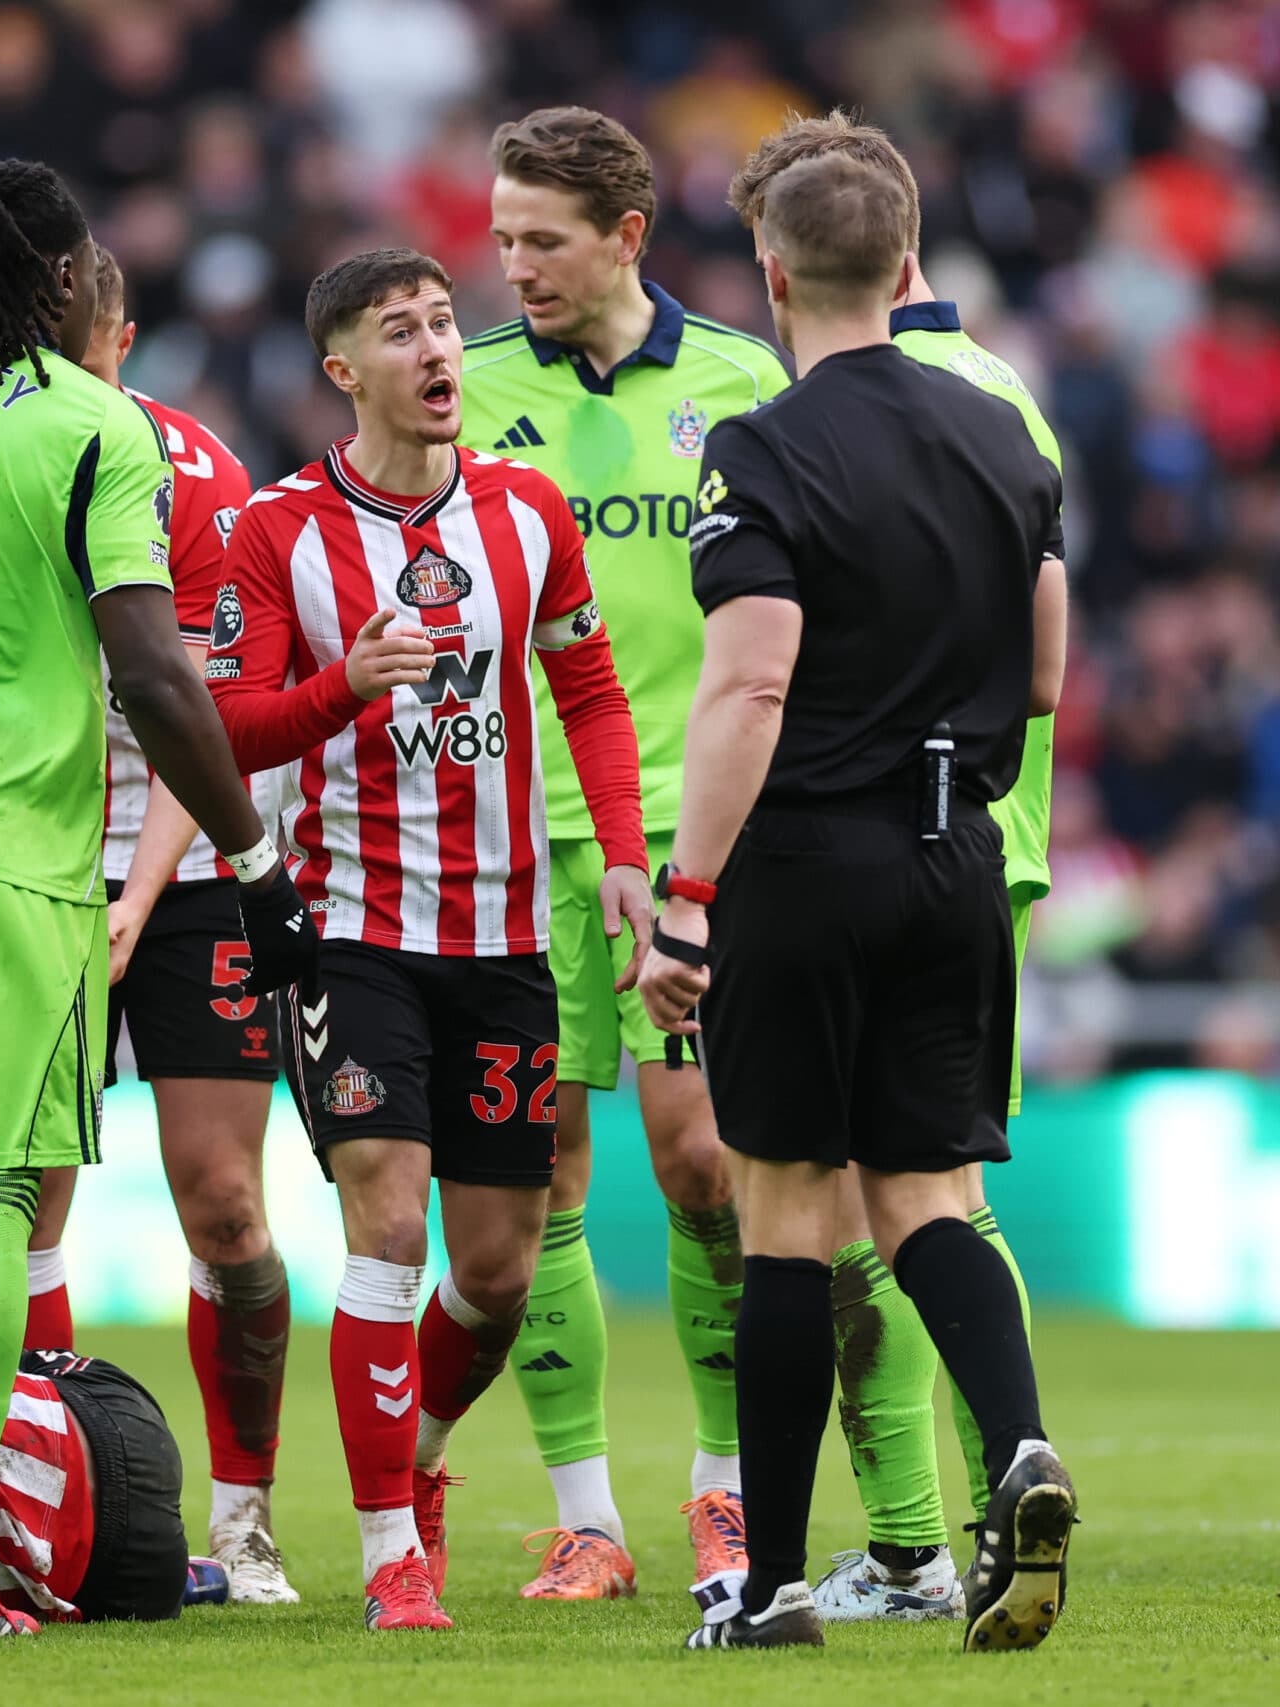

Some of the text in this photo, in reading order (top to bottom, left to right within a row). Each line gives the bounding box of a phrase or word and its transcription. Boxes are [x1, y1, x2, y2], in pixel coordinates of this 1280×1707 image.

[429, 622, 473, 638] hummel
[210, 658, 237, 669] room
[207, 668, 240, 679] racism
[388, 711, 506, 767] W88
[311, 900, 337, 911] ECO8
[209, 941, 258, 1020] 5
[469, 1042, 558, 1123] 32
